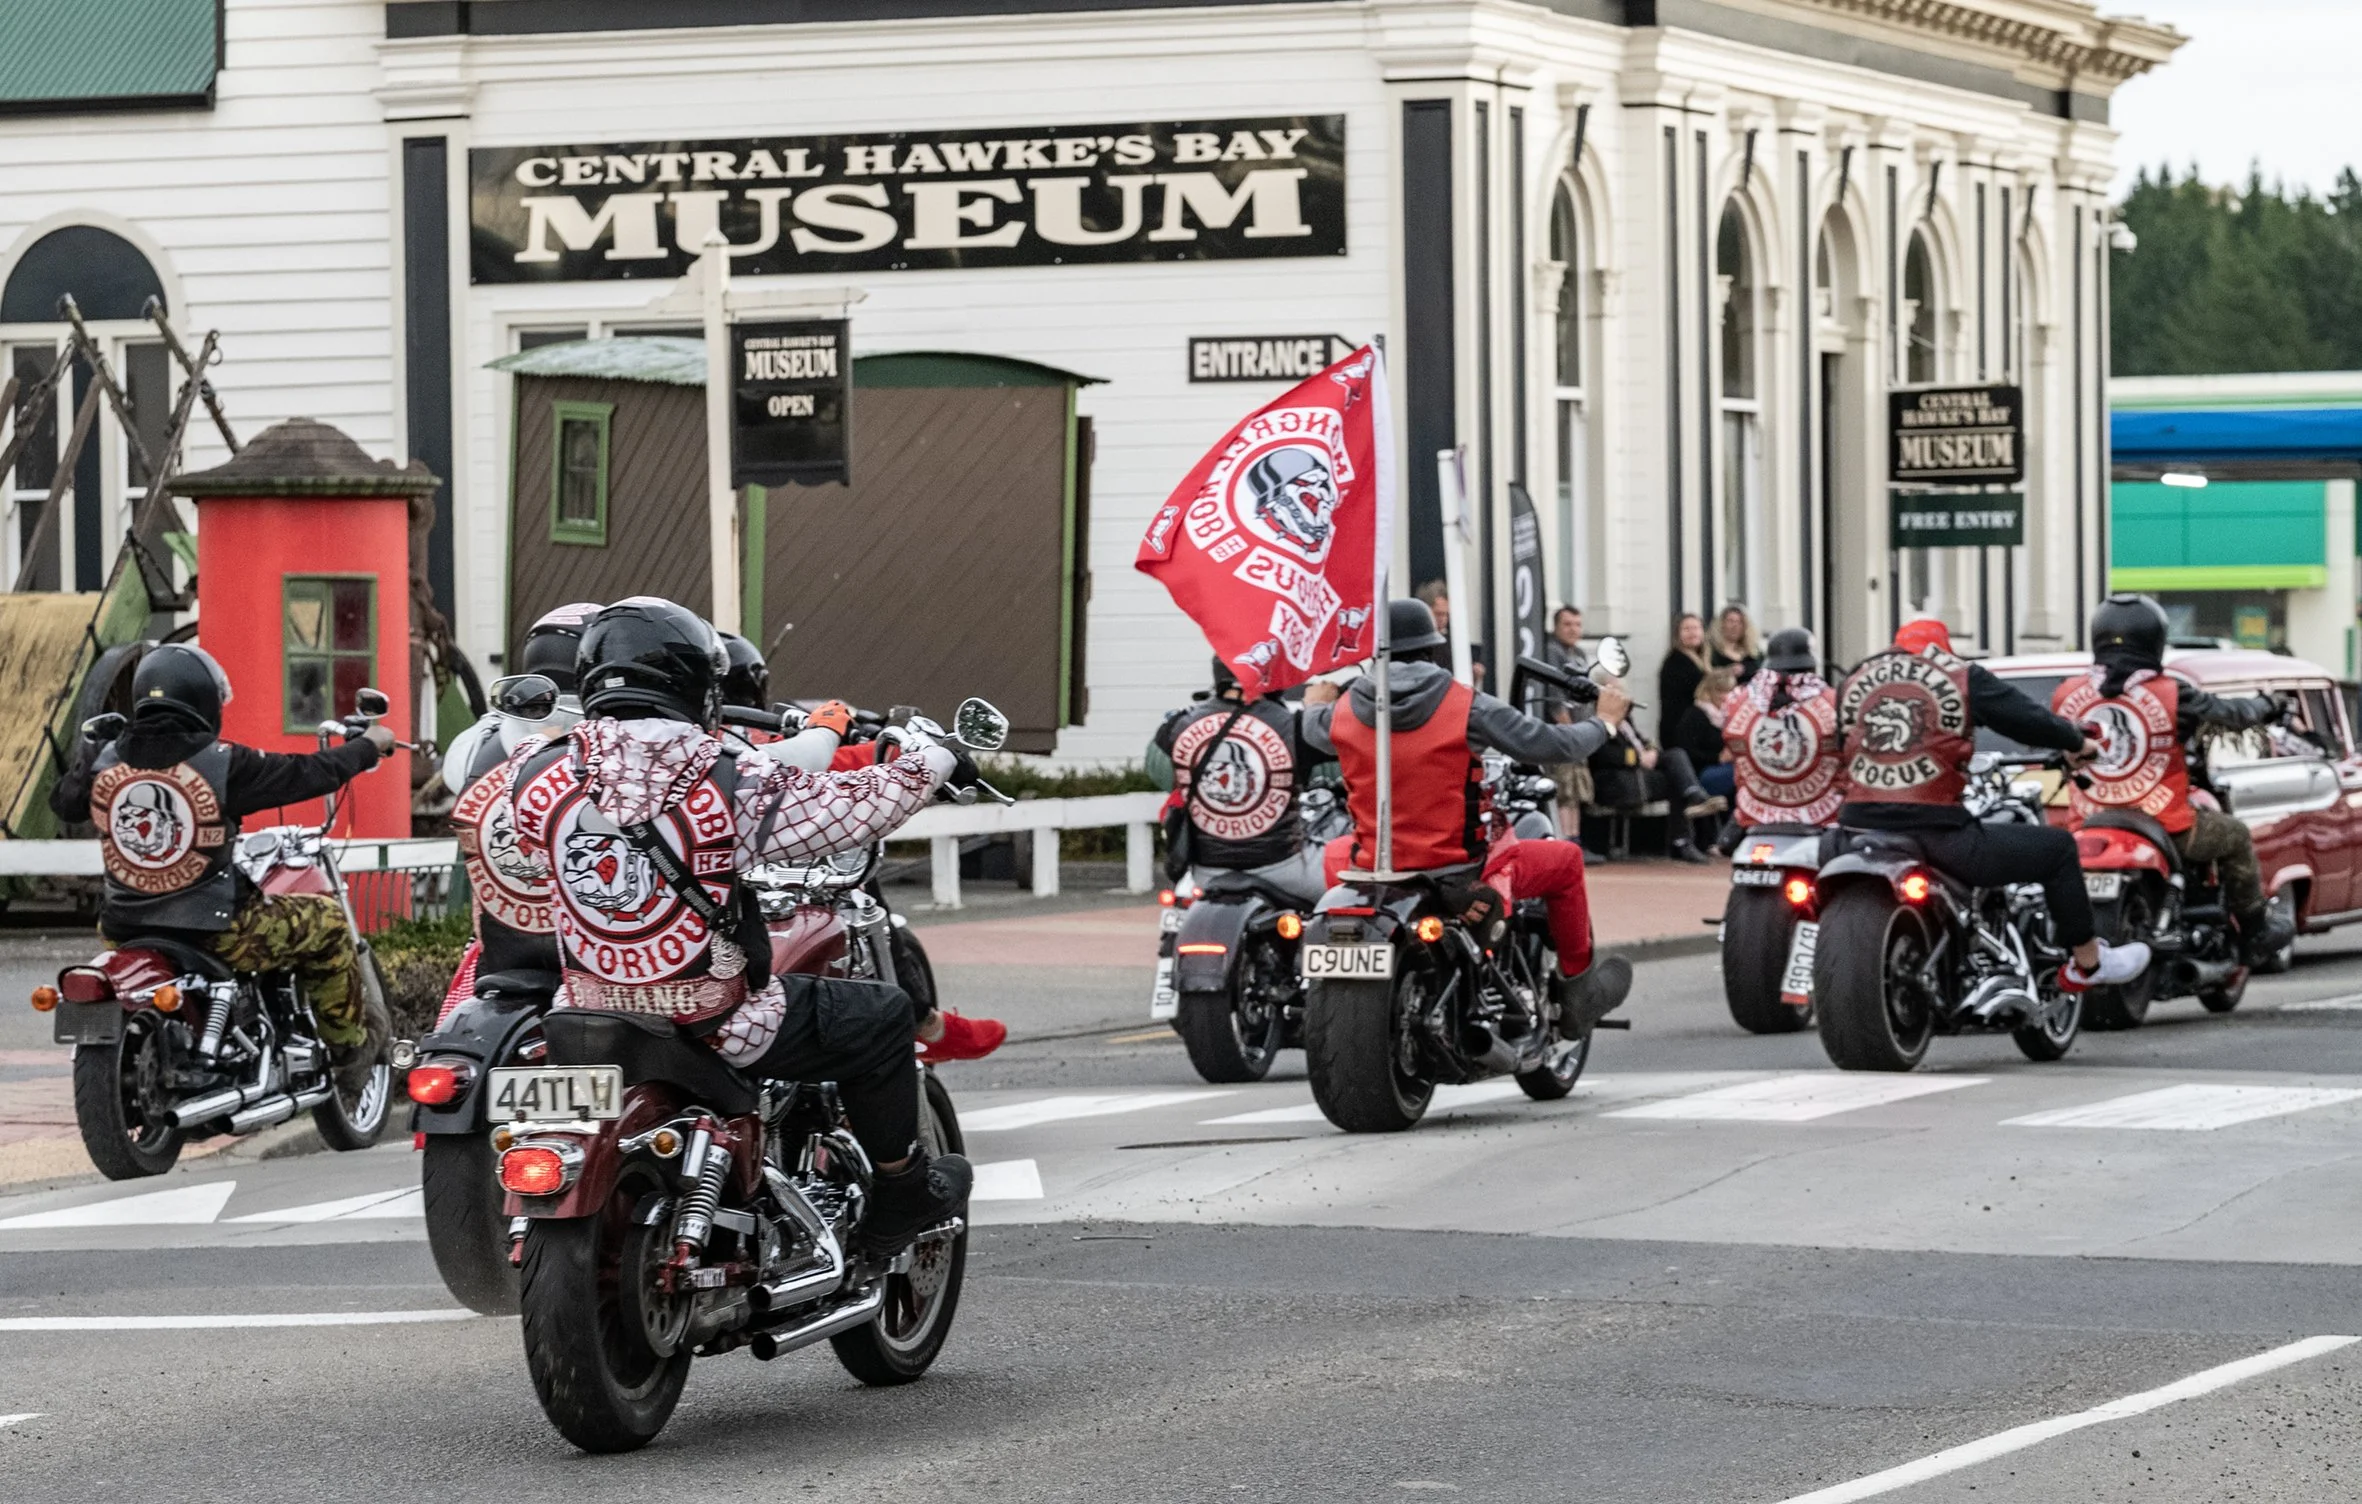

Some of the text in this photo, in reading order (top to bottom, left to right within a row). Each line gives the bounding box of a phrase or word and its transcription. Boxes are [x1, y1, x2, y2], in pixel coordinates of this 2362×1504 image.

[514, 128, 1311, 188] CENTRAL HAWKE'S BAY
[513, 167, 1314, 264] MUSEUM
[744, 347, 838, 380] MUSEUM
[1194, 339, 1326, 378] ENTRANCE
[767, 394, 815, 417] OPEN
[1898, 432, 2015, 469] MUSEUM
[1899, 510, 2016, 530] FREE ENTRY
[1844, 662, 1962, 729] MONGREL MOB
[1853, 756, 1936, 786] ROGUE
[2096, 754, 2166, 799] ORIOUS
[185, 776, 217, 818] MOB
[686, 788, 727, 839] OB
[1191, 791, 1287, 836] OTORIOUS
[470, 865, 556, 928] NOTOR
[1308, 948, 1387, 973] C9UNE
